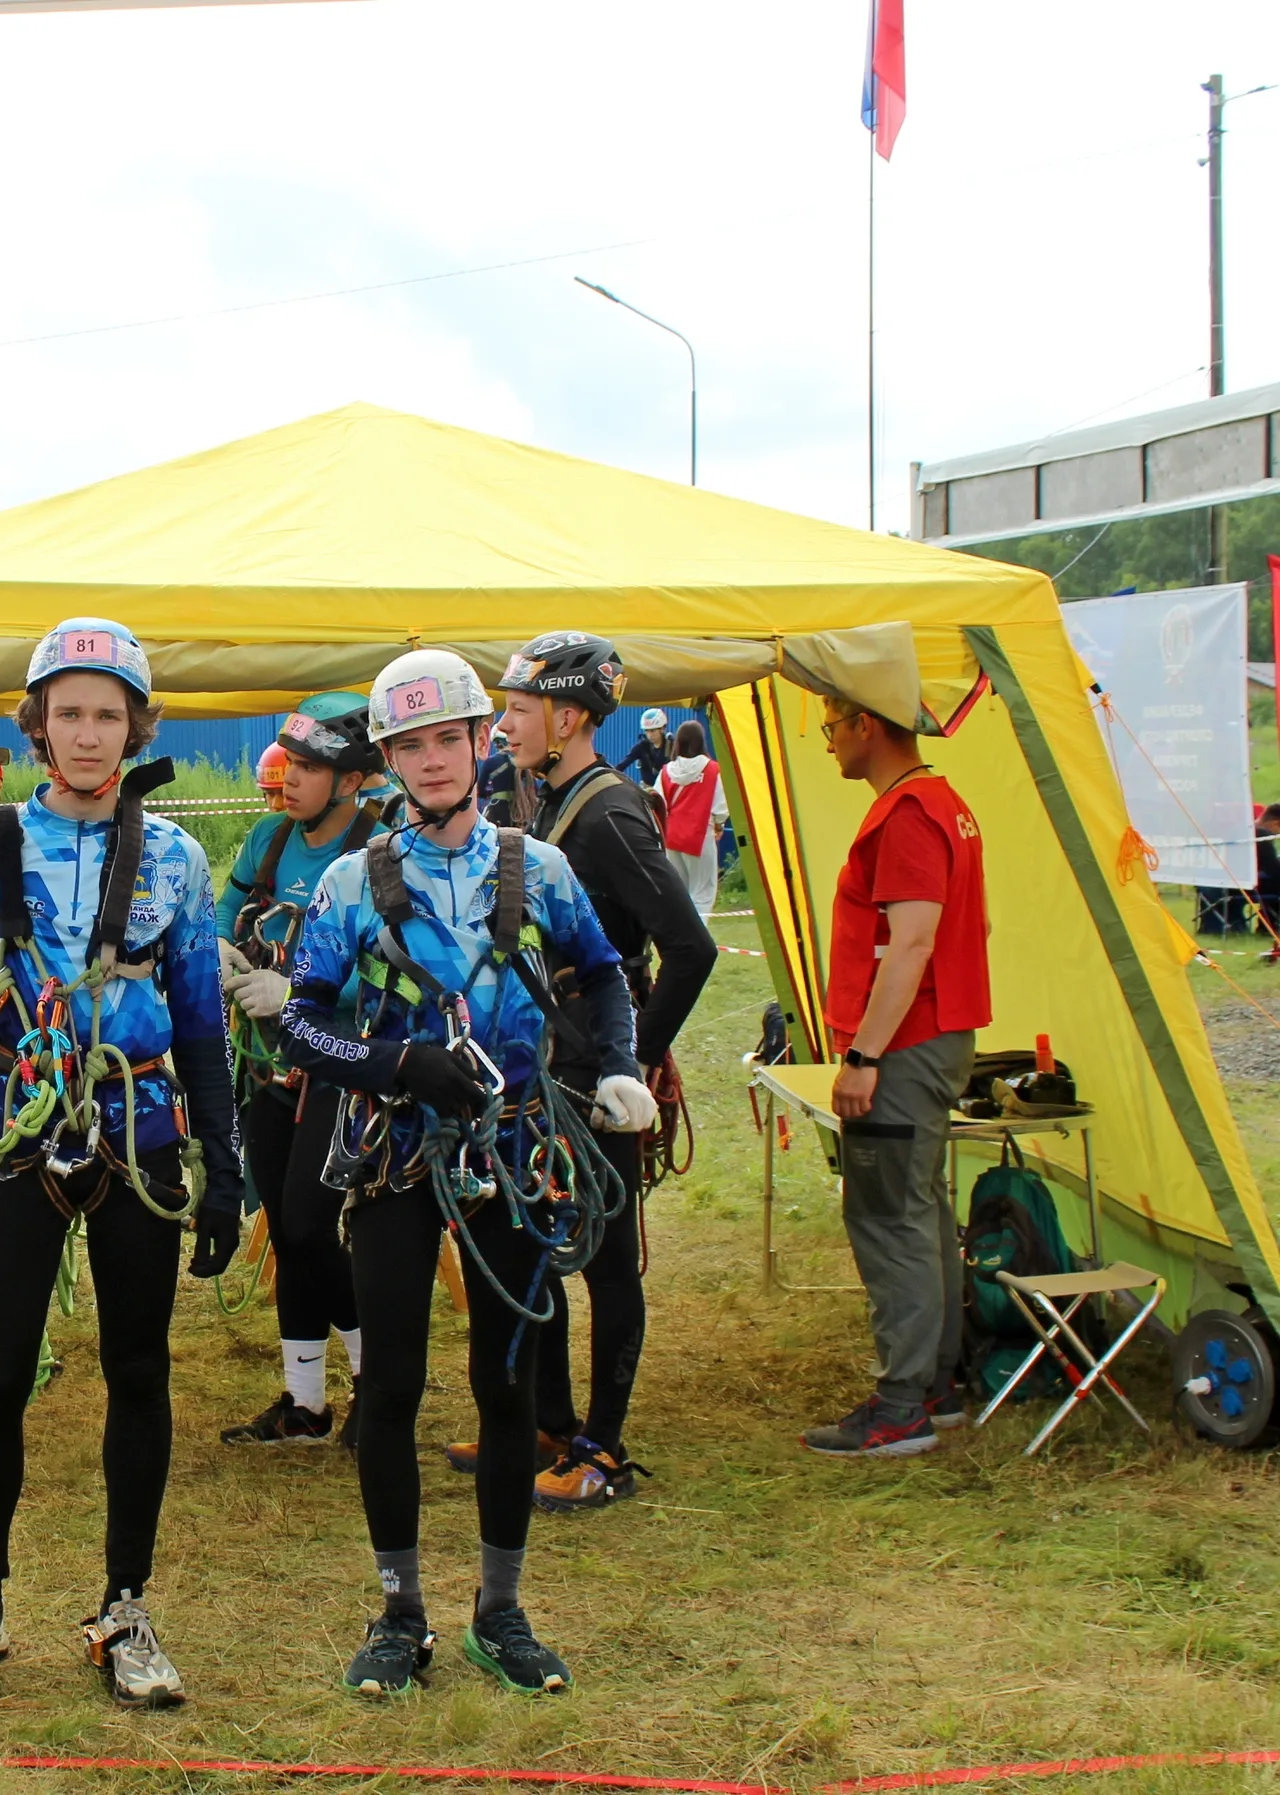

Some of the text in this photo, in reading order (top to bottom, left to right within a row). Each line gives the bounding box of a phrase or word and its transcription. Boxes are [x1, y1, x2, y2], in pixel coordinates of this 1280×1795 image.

[76, 638, 95, 653] 81
[538, 675, 586, 691] VENTO
[406, 690, 427, 710] 82
[291, 719, 305, 733] 92
